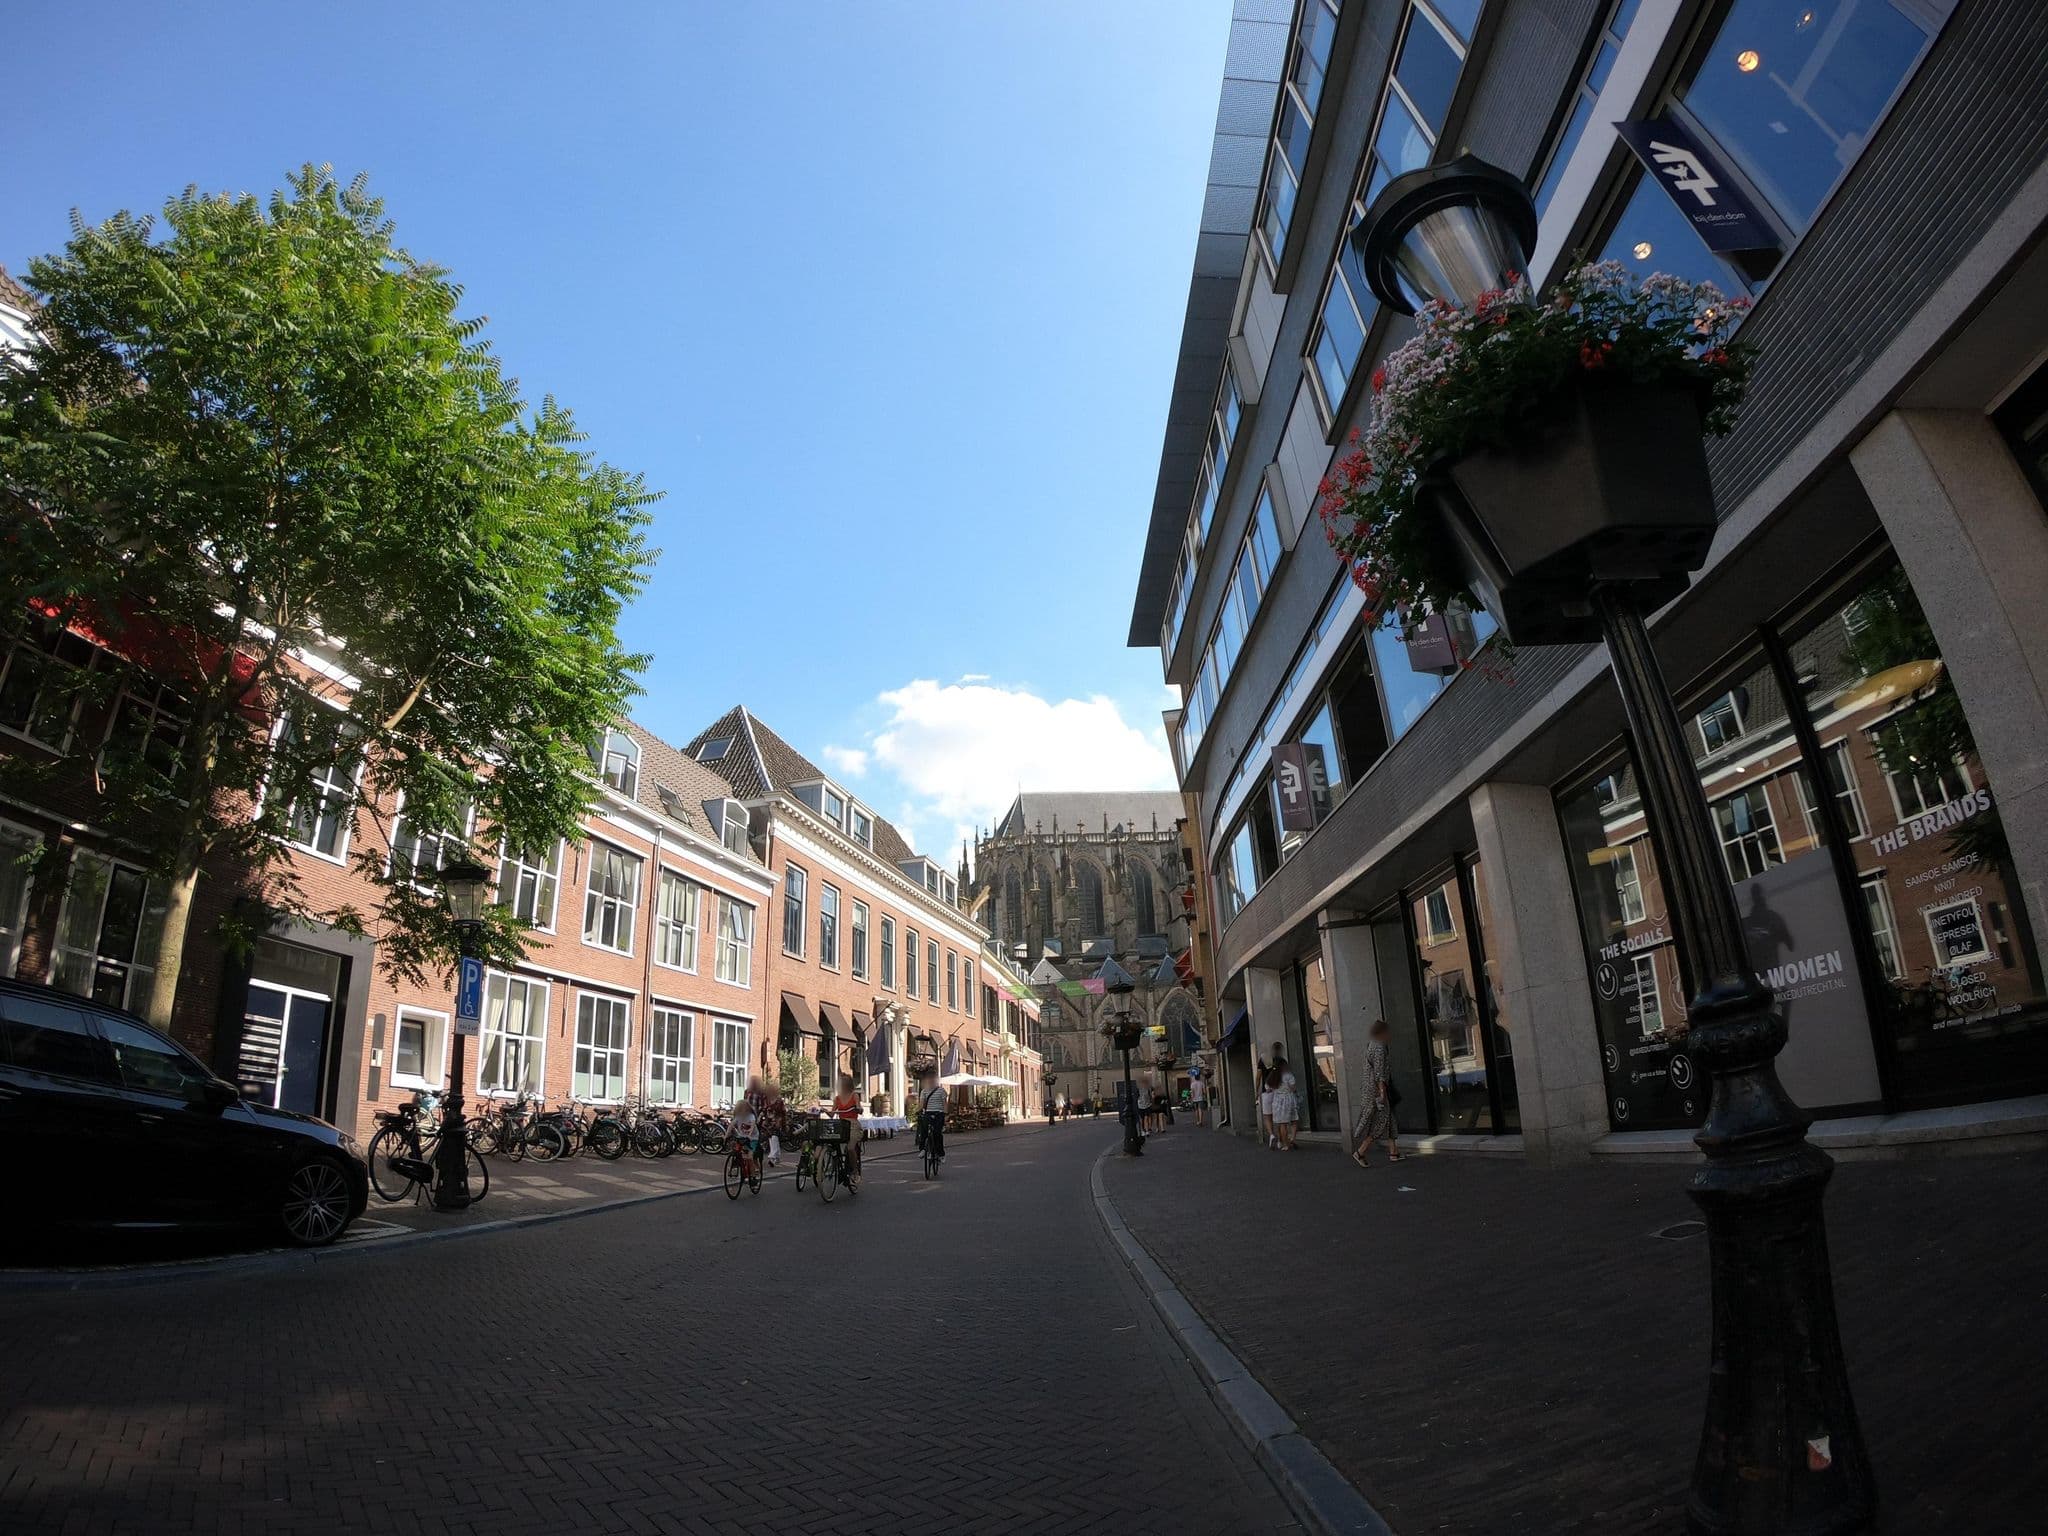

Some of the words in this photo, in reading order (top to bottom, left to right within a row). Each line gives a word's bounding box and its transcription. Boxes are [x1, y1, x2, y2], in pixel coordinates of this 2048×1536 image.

[1870, 826, 1909, 857] THE
[1910, 789, 1991, 841] BRANDS
[1905, 867, 1941, 888] SAMSOE
[1941, 851, 1980, 875] SAMSOE
[1933, 878, 1957, 894] NN07
[1600, 943, 1620, 961] THE
[1620, 927, 1664, 955] SOCIALS
[1932, 919, 1983, 944] REPRESEN
[465, 963, 478, 993] P
[1767, 950, 1843, 989] WOMEN
[1950, 971, 1987, 988] CLOSED
[1946, 986, 1997, 1006] WOOLRICH
